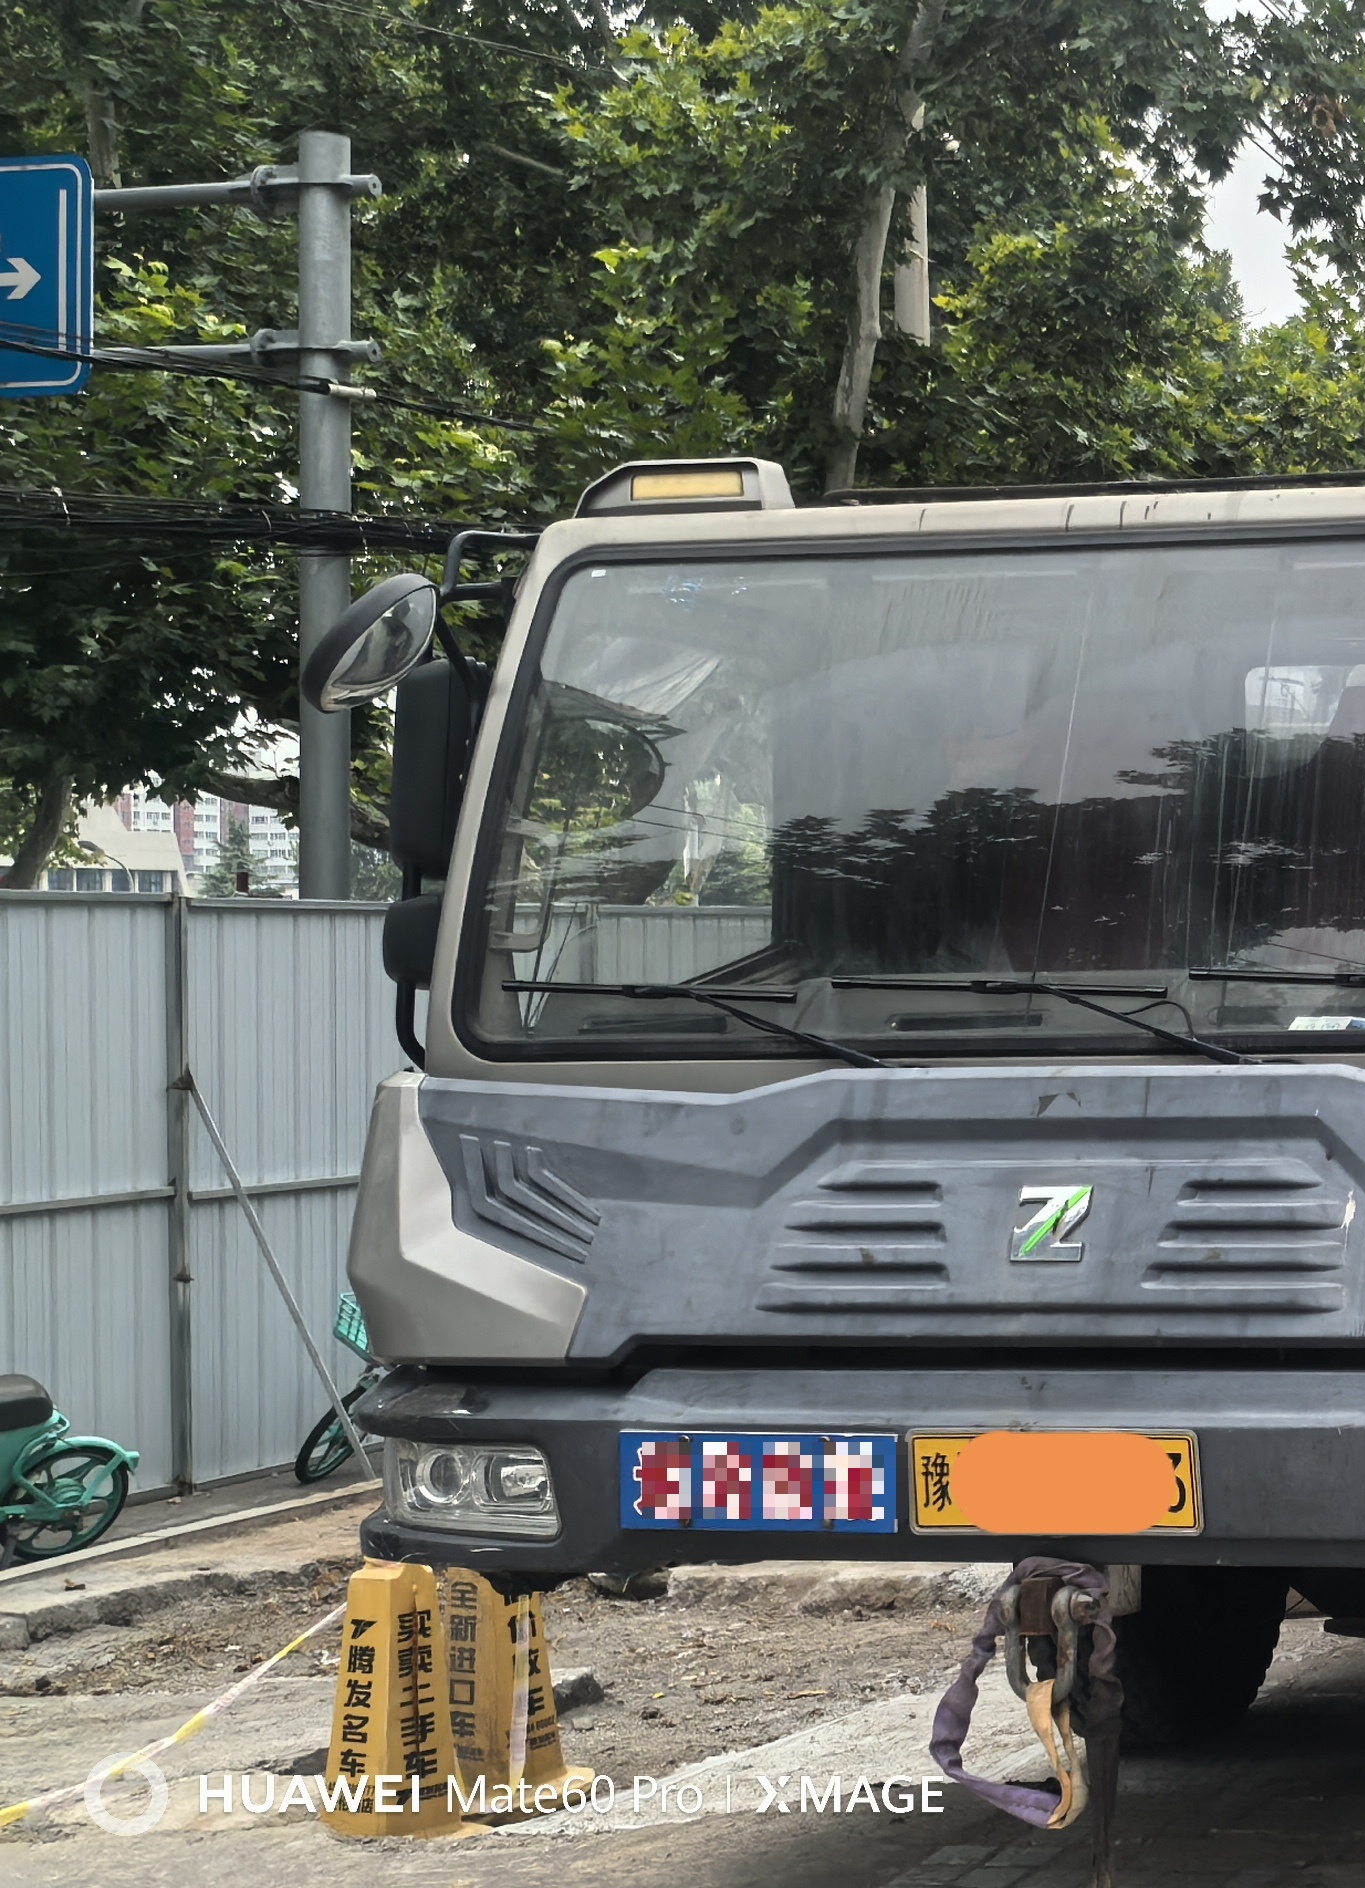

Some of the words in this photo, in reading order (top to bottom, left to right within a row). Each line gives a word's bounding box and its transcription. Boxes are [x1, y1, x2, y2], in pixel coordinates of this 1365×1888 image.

[339, 1645, 375, 1778] 腾发名车
[397, 1609, 438, 1780] 买卖二手车
[449, 1581, 478, 1738] 全新进口车
